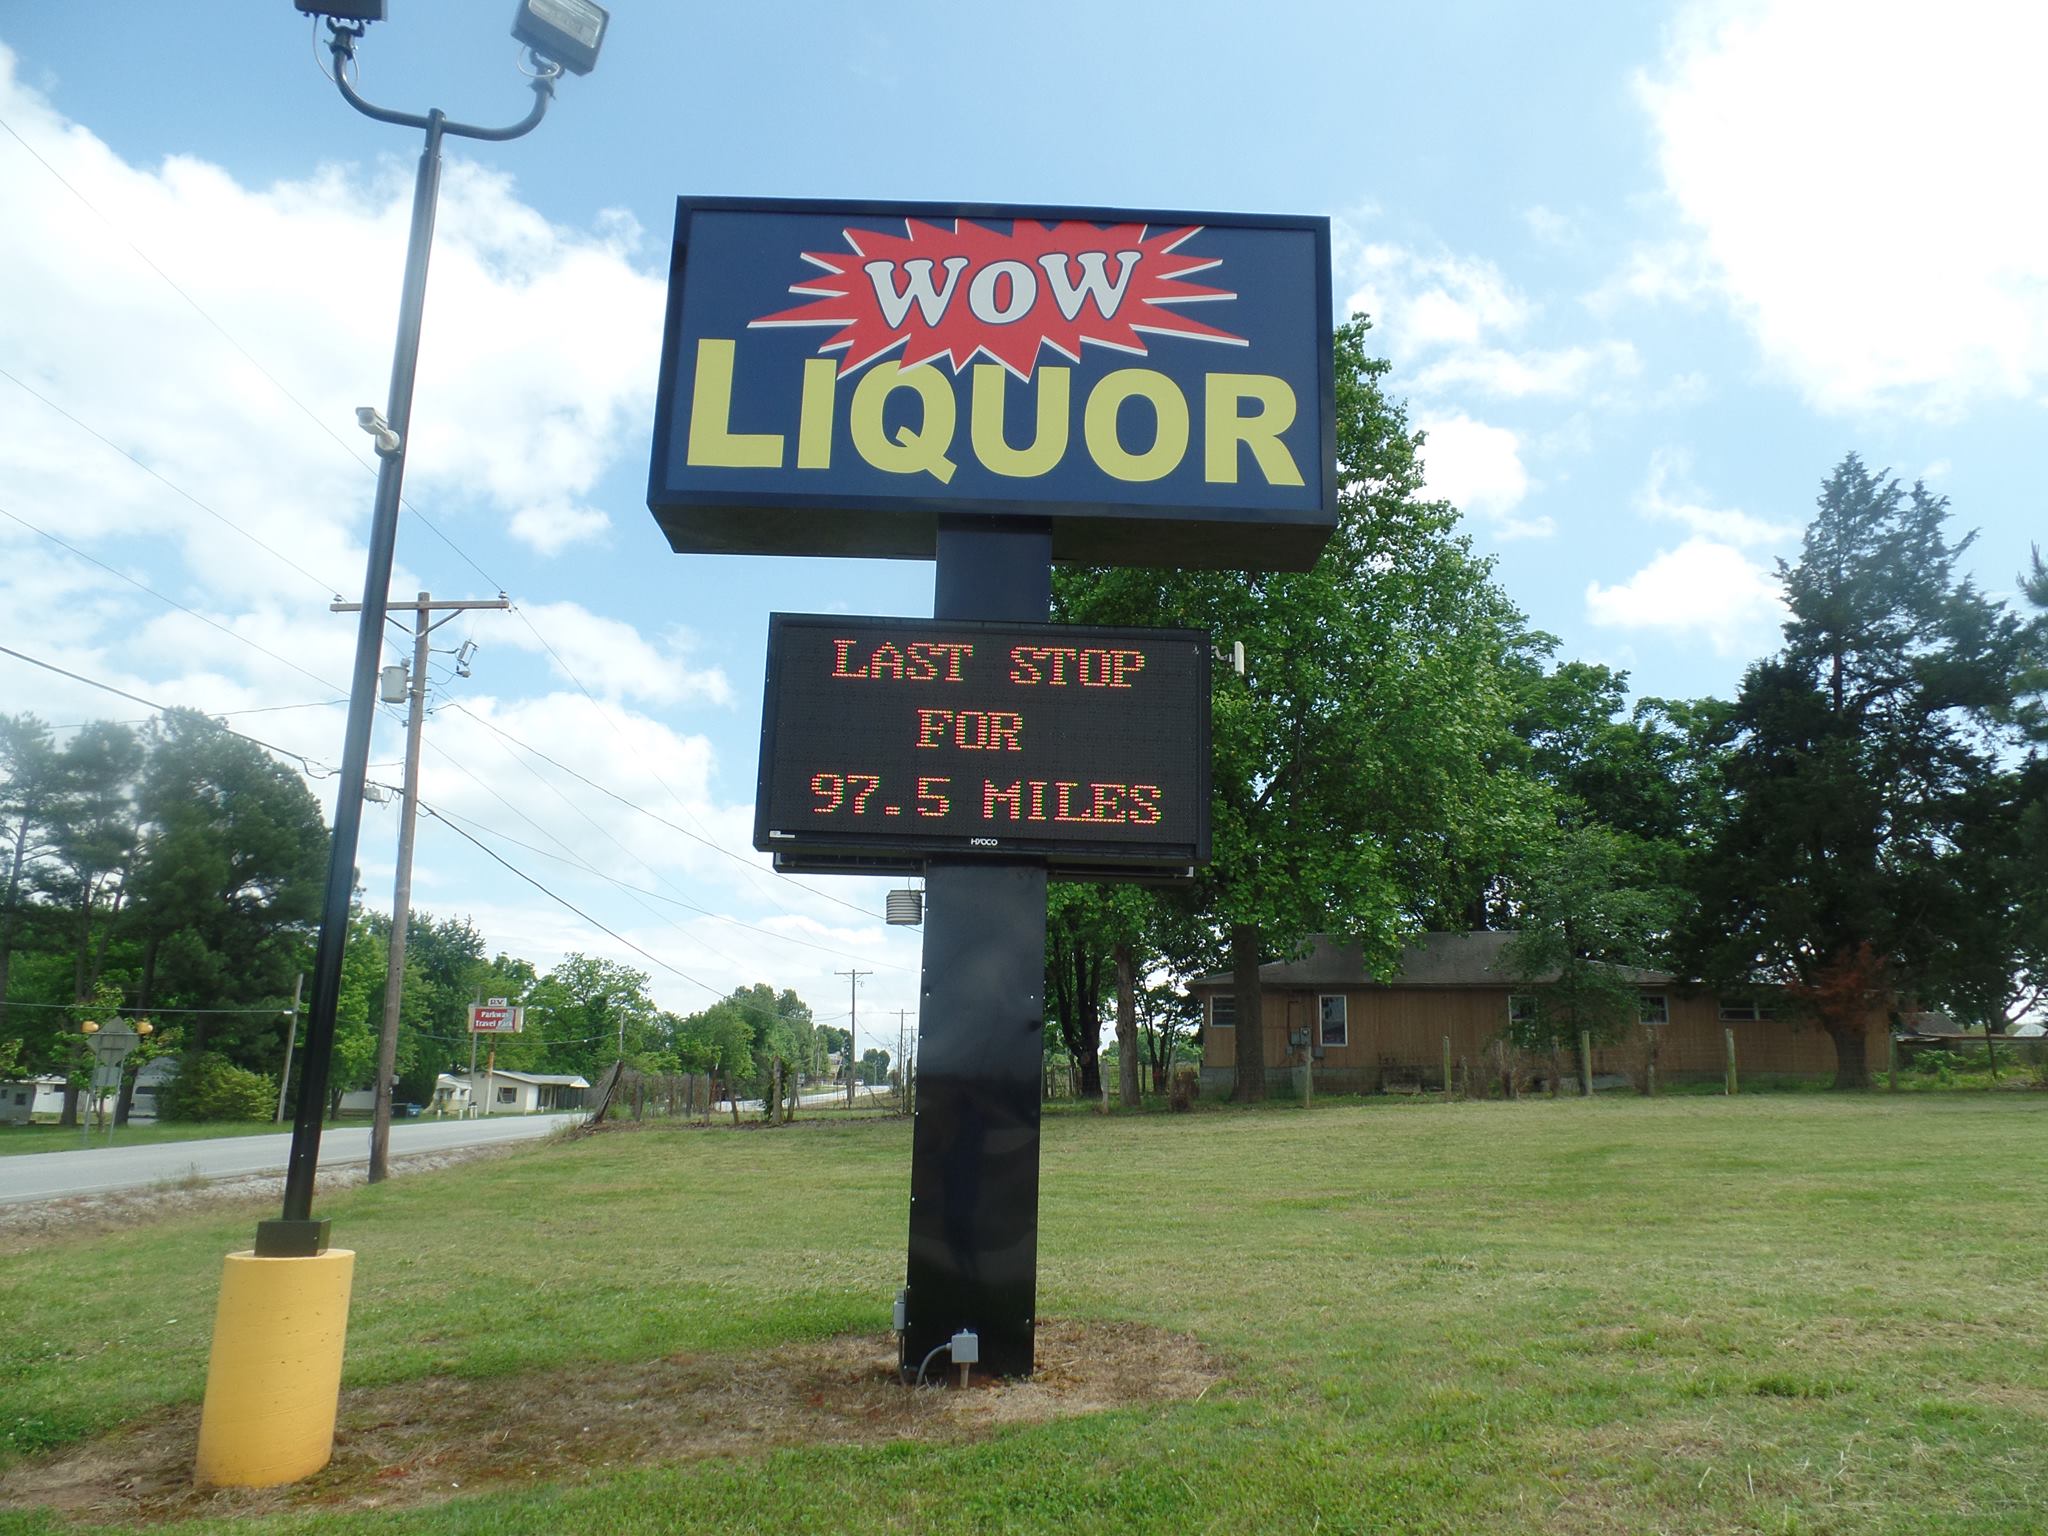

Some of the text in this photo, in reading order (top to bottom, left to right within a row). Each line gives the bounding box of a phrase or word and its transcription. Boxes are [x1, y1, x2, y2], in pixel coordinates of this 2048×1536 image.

[864, 250, 1142, 329] WOW
[686, 338, 1306, 486] LIQUOR
[831, 639, 1145, 688] LAST STOP
[916, 709, 1024, 751] FOR
[810, 773, 1162, 825] 97.5 MILES
